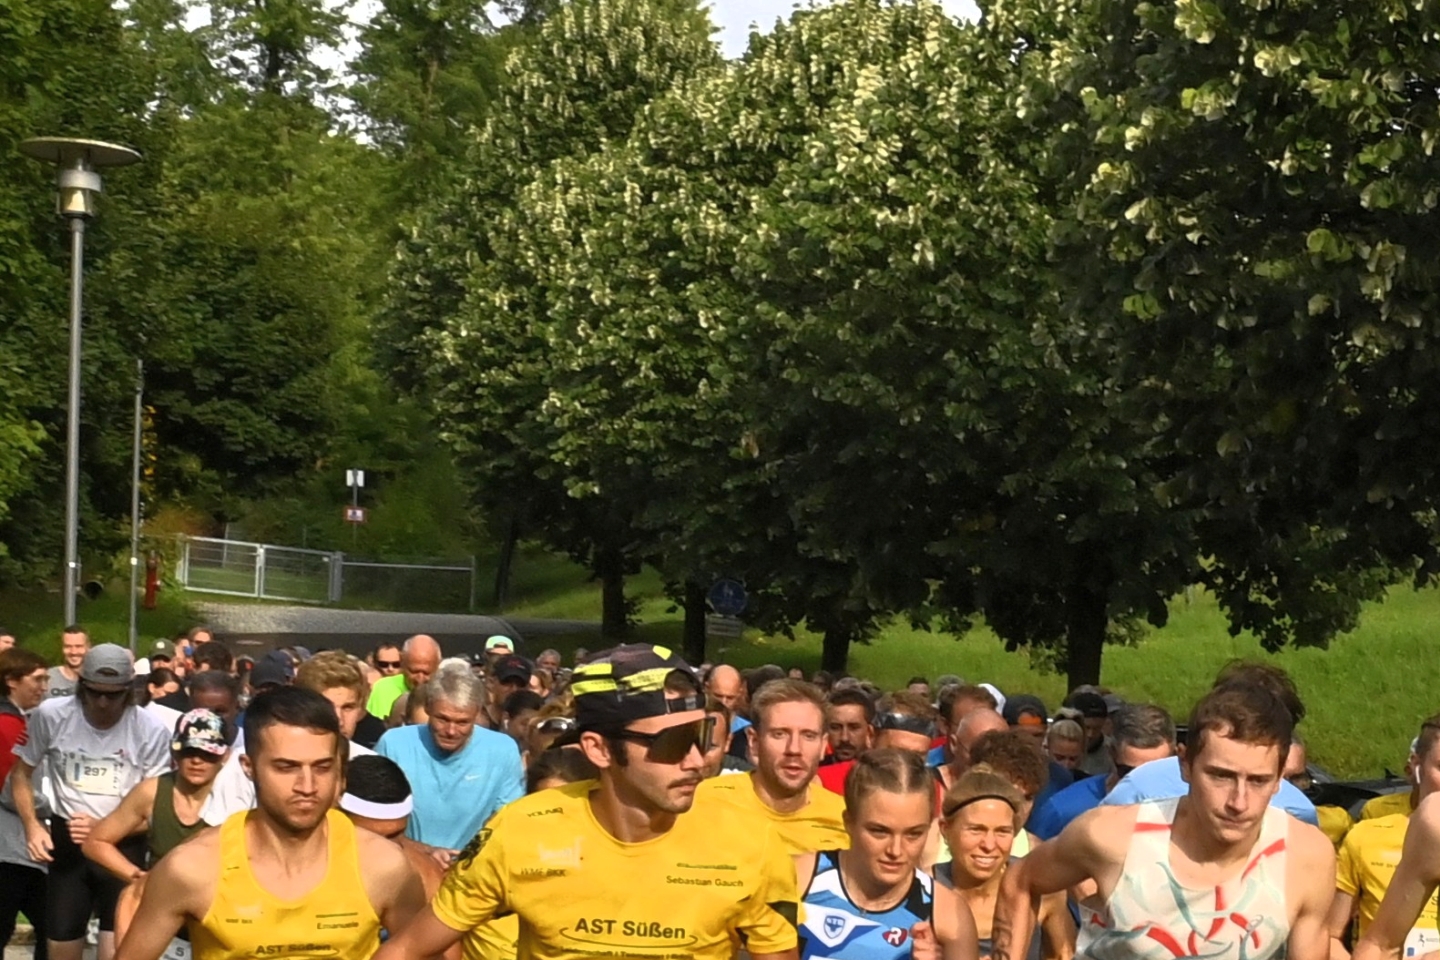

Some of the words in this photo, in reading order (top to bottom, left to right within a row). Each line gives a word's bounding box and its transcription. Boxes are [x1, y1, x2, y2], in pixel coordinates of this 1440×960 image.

[83, 766, 107, 777] 297
[666, 875, 713, 886] Sebastian
[714, 878, 744, 888] Gauch
[575, 918, 617, 935] AST
[622, 920, 686, 939] Süßen
[255, 944, 284, 955] AST
